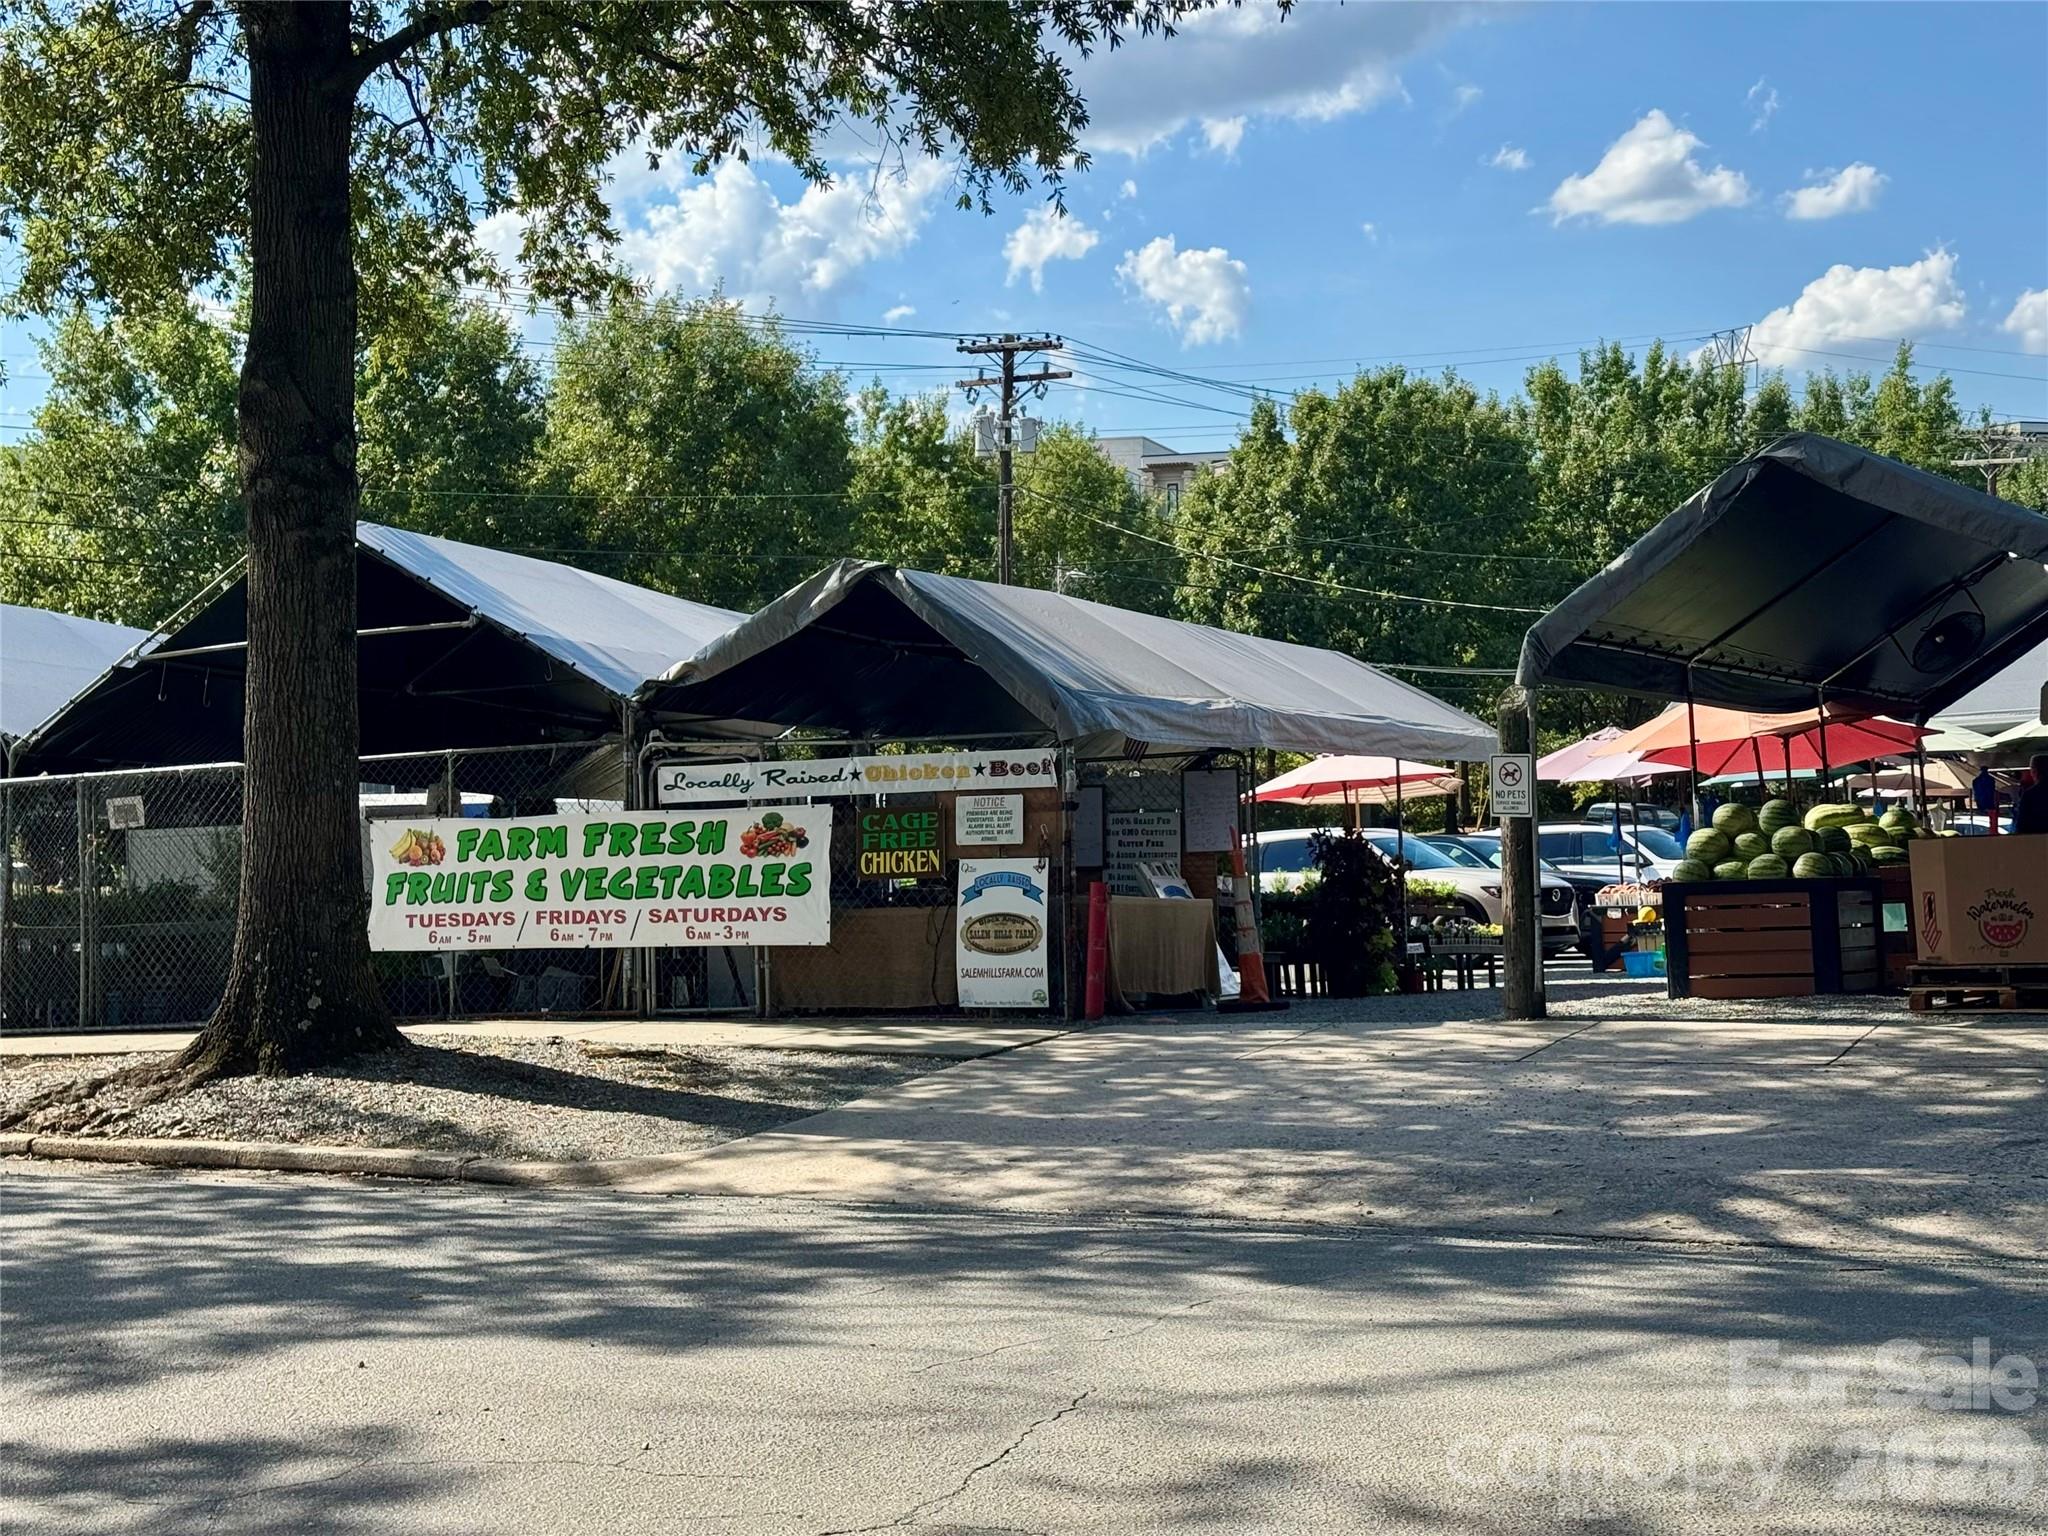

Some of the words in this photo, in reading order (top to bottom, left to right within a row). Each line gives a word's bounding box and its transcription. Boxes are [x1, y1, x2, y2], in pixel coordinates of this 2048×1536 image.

[664, 772, 754, 793] Locally
[761, 768, 848, 786] Raised
[864, 762, 970, 782] Chicken
[988, 757, 1052, 777] Beef
[974, 796, 1006, 807] NOTICE
[1496, 790, 1506, 799] NO
[1508, 790, 1526, 799] PETS
[862, 812, 939, 831] CAGE
[456, 825, 568, 862] FARM
[582, 820, 728, 857] FRESH
[862, 831, 937, 850] FREE
[860, 849, 940, 874] CHICKEN
[385, 870, 514, 906] FRUITS
[524, 868, 547, 901] &
[561, 862, 812, 902] VEGETABLES
[976, 874, 1004, 888] LOCALLY
[1008, 874, 1030, 888] RAISED
[1984, 888, 2016, 900] Fresh
[406, 912, 516, 928] TUESDAYS
[536, 908, 627, 926] FRIDAYS
[648, 906, 788, 924] SATURDAYS
[1966, 899, 2034, 920] Watermelon
[970, 930, 991, 939] SALEM
[994, 930, 1012, 939] HILLS
[1016, 929, 1034, 939] FARM
[960, 968, 1044, 978] SALEMHILLSFARM.COM
